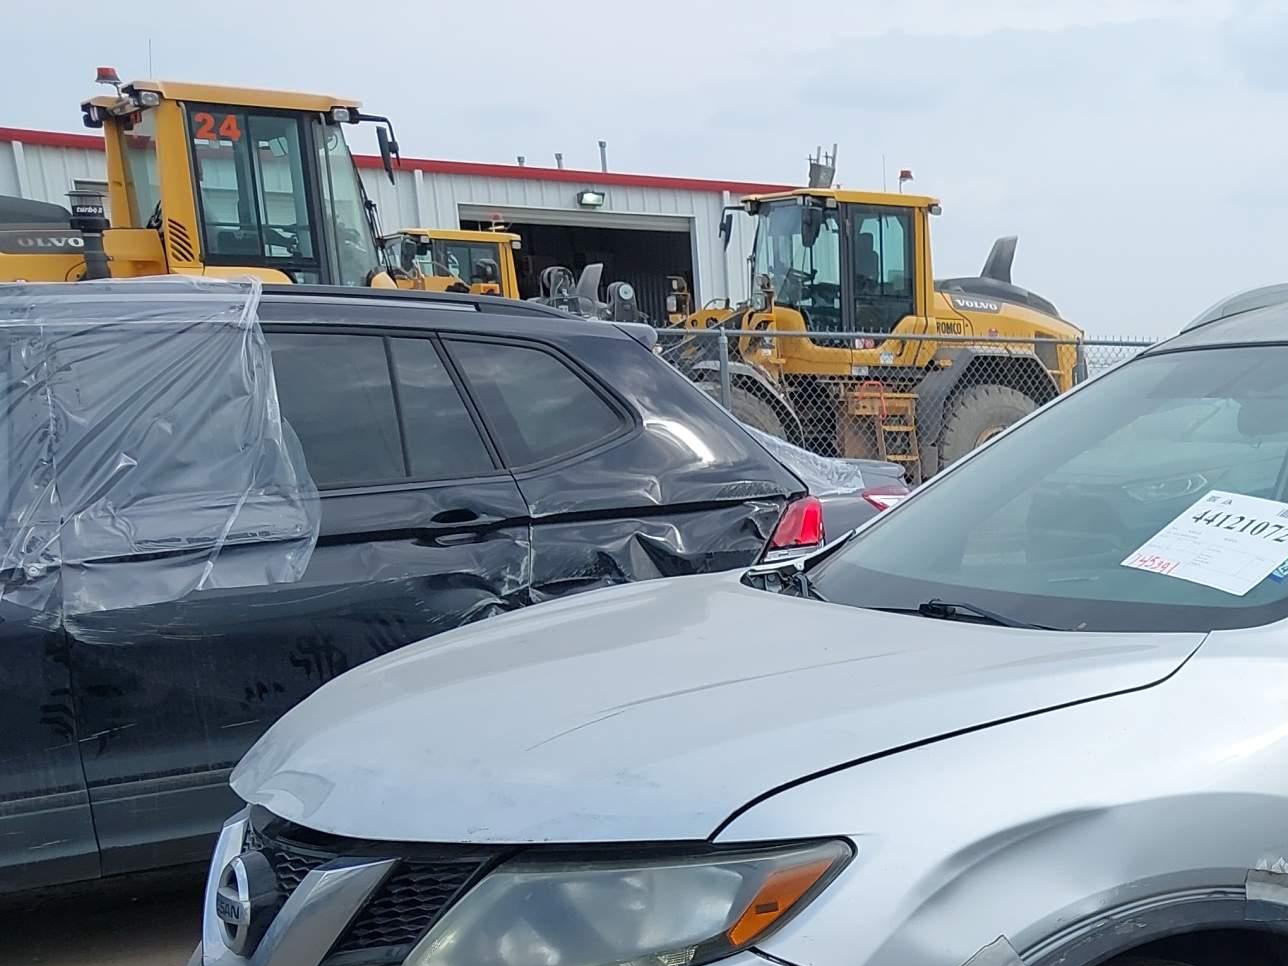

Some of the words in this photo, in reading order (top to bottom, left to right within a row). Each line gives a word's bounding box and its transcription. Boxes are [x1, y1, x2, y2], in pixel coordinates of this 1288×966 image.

[193, 111, 241, 142] 24
[956, 298, 998, 311] VOLVO
[936, 321, 962, 335] ROMCO
